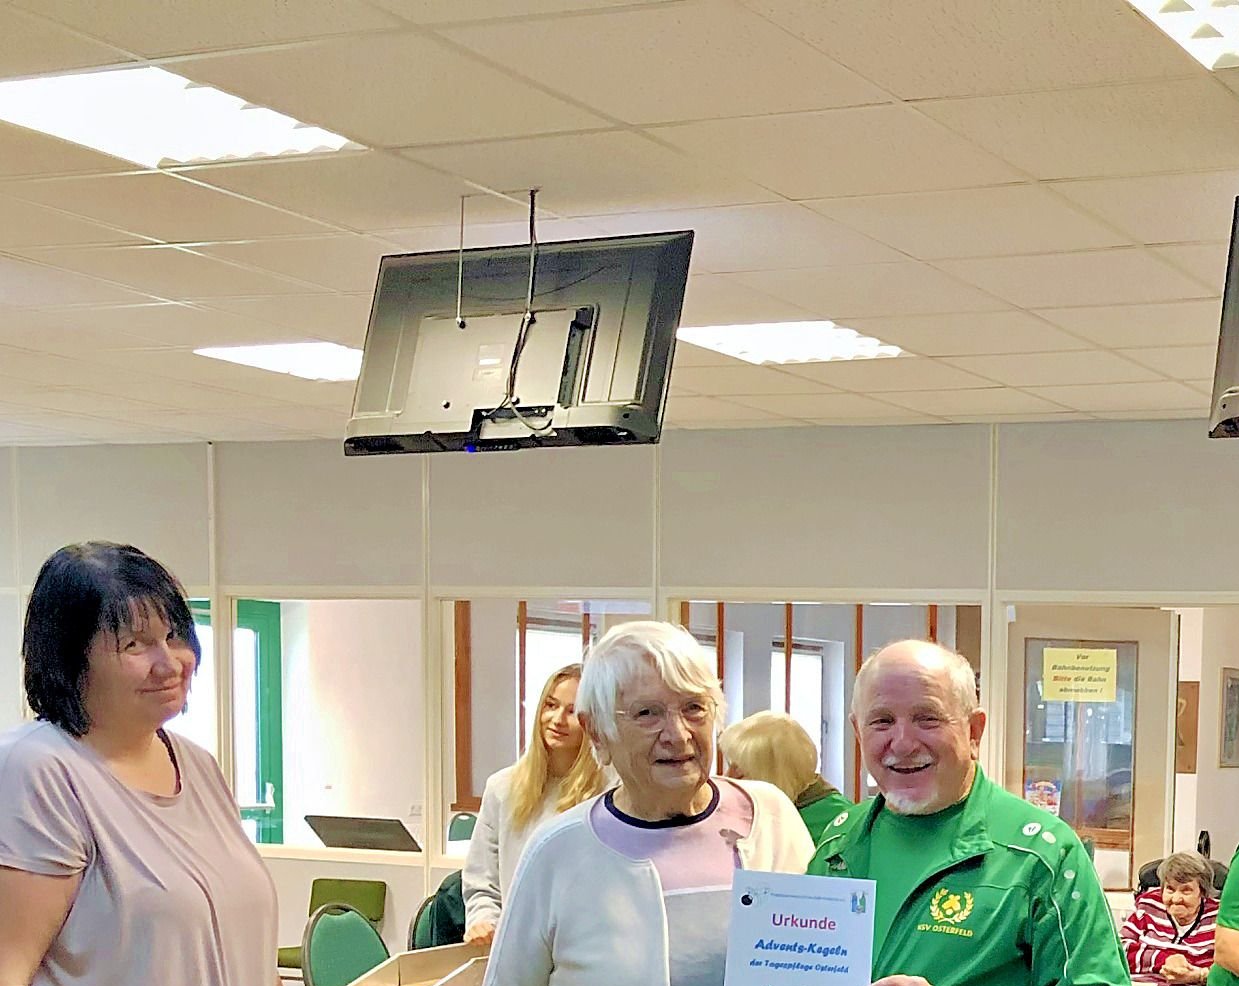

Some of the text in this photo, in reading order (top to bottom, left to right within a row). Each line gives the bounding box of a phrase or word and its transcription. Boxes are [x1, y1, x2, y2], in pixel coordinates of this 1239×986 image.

[1051, 664, 1111, 673] Bahnbenutzung
[1087, 675, 1107, 683] Bahn
[772, 913, 837, 931] Urkunde
[932, 925, 974, 937] OSTERFELD
[754, 938, 848, 957] Advents-Kegeln
